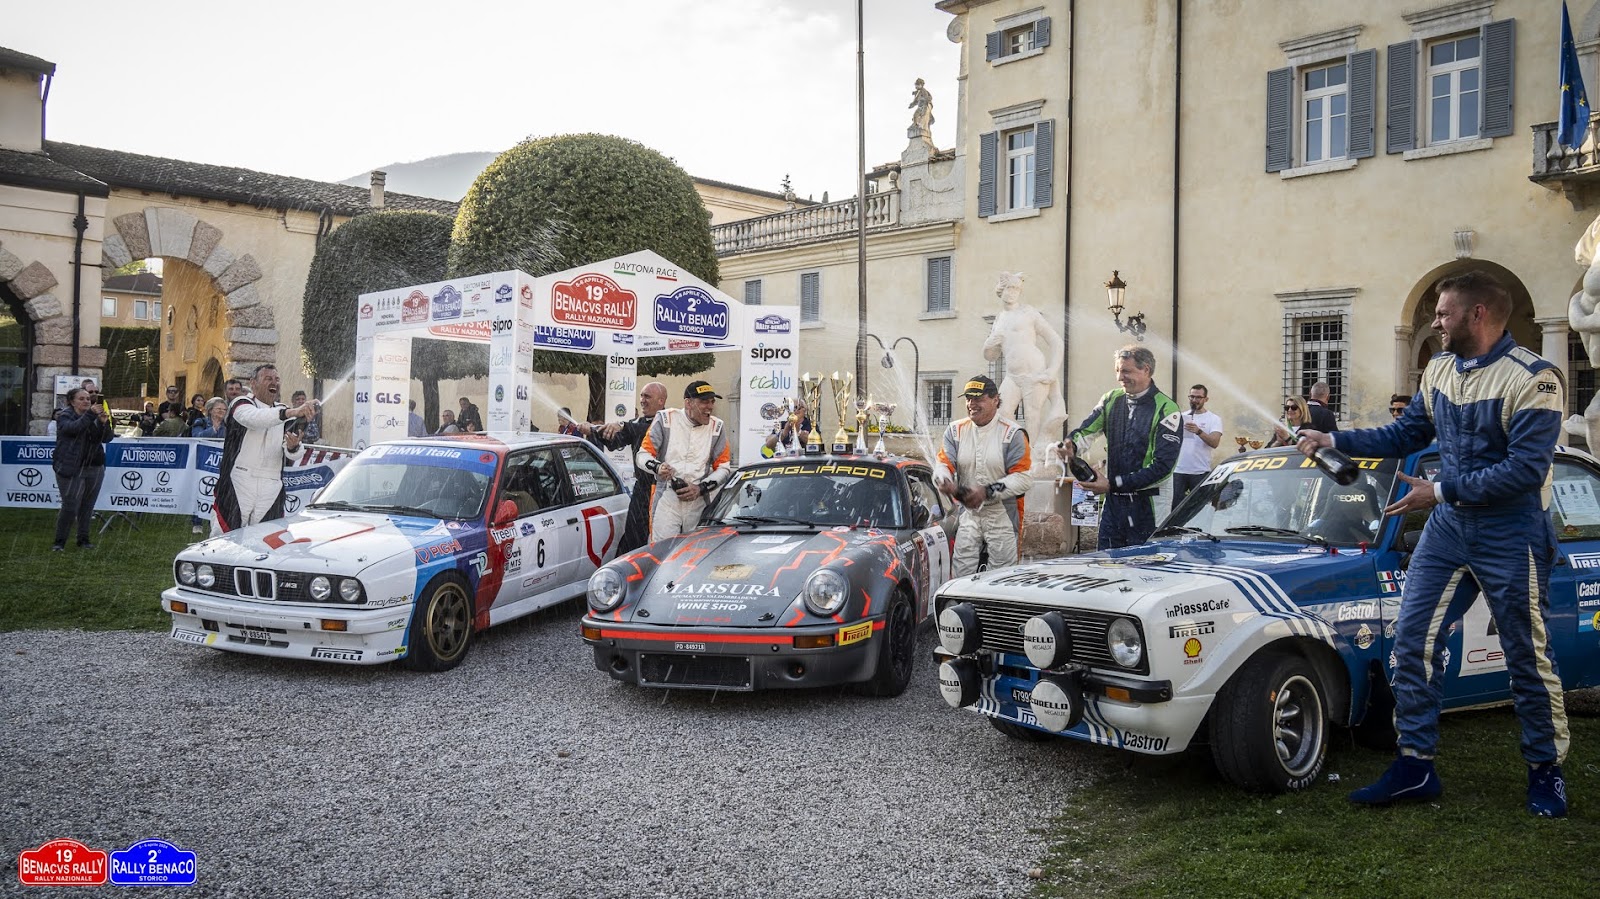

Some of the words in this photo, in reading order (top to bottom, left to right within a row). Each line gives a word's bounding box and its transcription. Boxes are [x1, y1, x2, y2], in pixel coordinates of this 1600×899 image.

[614, 262, 654, 274] DAYTONA
[656, 268, 678, 278] RACE
[555, 291, 601, 315] BENACVS
[603, 300, 634, 317] RALLY
[565, 313, 586, 322] RALLY
[587, 315, 624, 326] NAZIONALE
[657, 303, 687, 324] RALLY
[688, 312, 726, 328] BENACO
[492, 315, 513, 334] sipro
[534, 326, 556, 335] ALLY
[679, 325, 705, 334] STORICO
[461, 328, 491, 337] NAZIONAL
[610, 352, 635, 366] sipro
[750, 342, 791, 362] sipro
[750, 370, 791, 390] ecoblu
[356, 392, 369, 403] GLS
[516, 385, 528, 401] GLS
[121, 450, 176, 462] AUTOTORINO
[388, 445, 424, 457] BMW
[426, 446, 462, 459] Italia
[741, 465, 886, 480] GUAGLIARDO
[1232, 457, 1288, 473] ORD
[7, 493, 52, 503] VERONA
[110, 496, 149, 507] VERONA
[432, 539, 462, 558] PIGHI
[537, 538, 545, 568] 6
[656, 583, 781, 598] MARSURA
[1579, 582, 1600, 597] Castr
[677, 602, 709, 610] WINE
[710, 603, 747, 611] SHOP
[1579, 599, 1600, 607] CAREL
[1338, 603, 1375, 621] Castrol
[172, 627, 208, 644] PIRELLI
[843, 625, 870, 642] PIRELLI
[1169, 620, 1215, 639] PIRELLI
[311, 647, 364, 661] PIRELLI
[1123, 731, 1171, 752] Castrol
